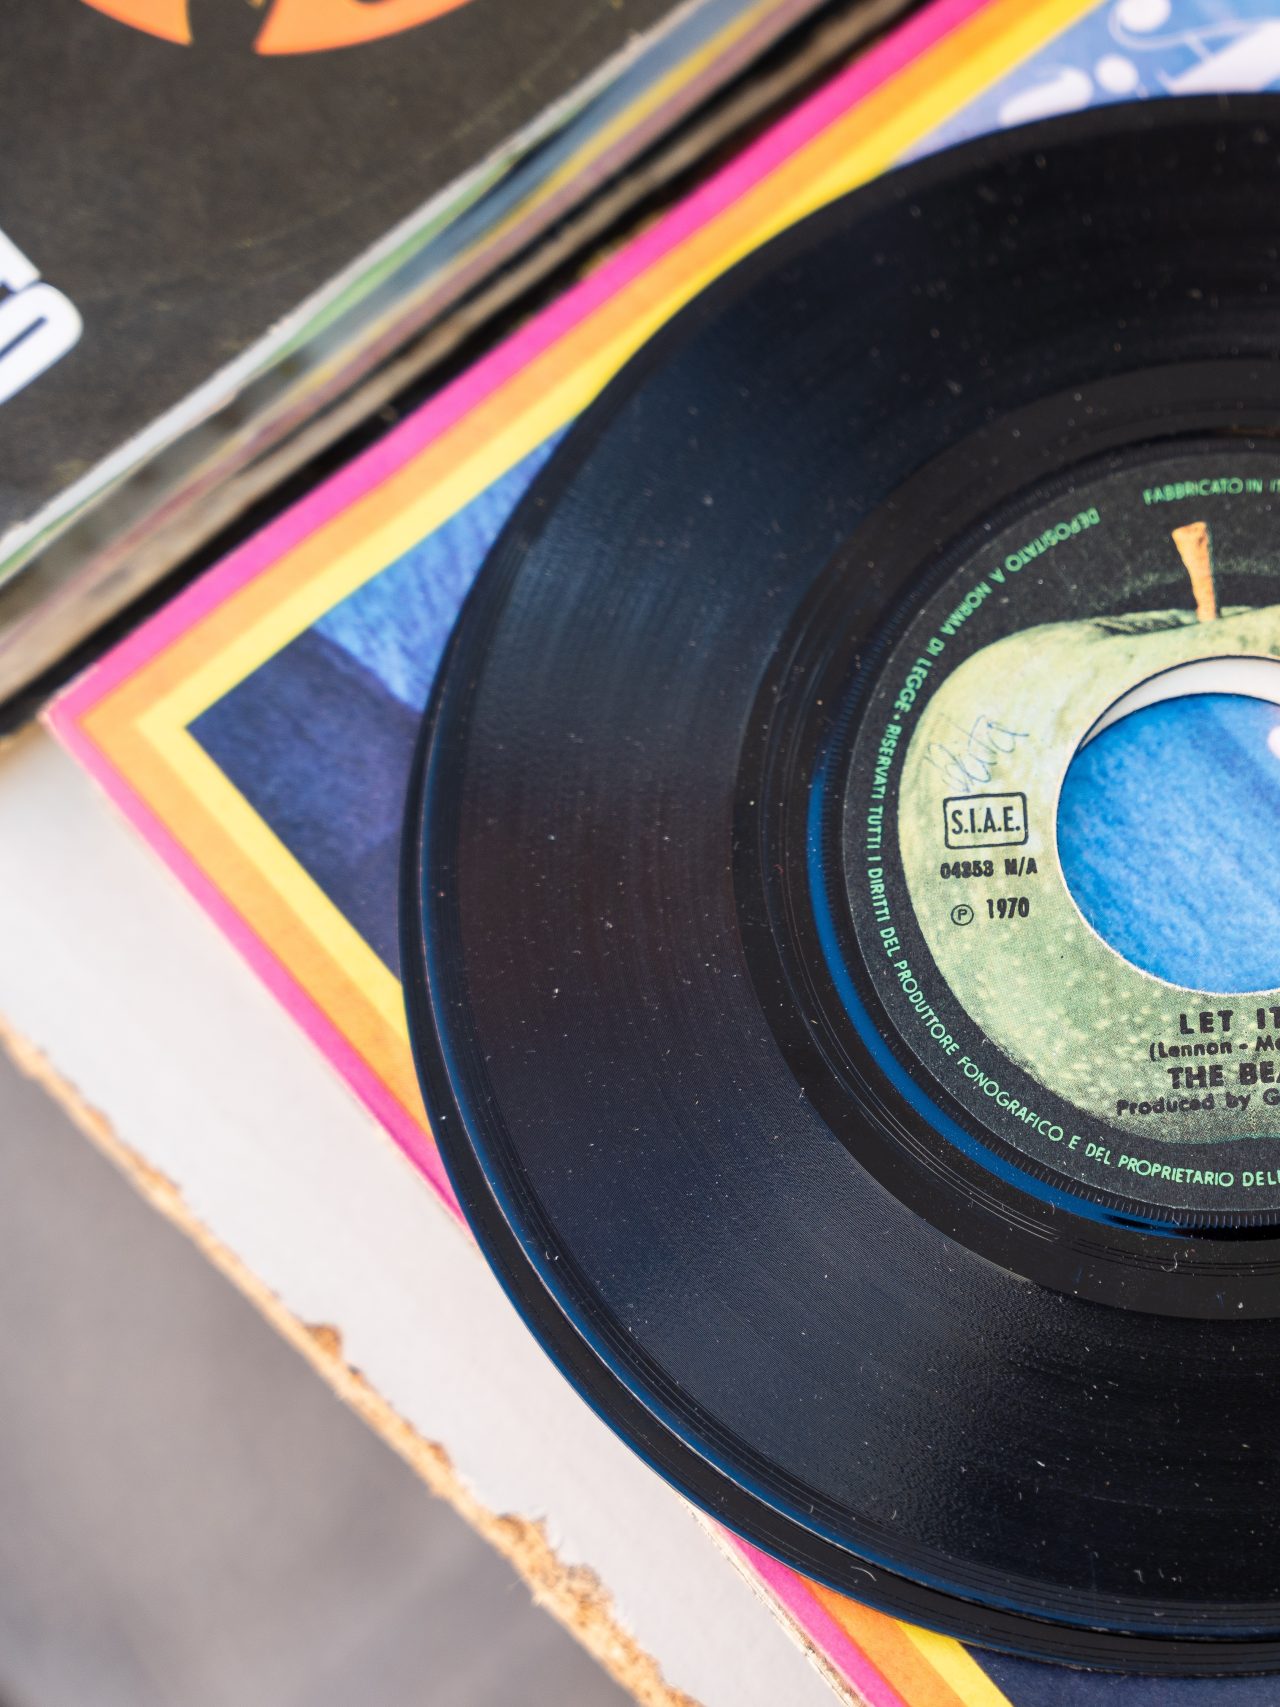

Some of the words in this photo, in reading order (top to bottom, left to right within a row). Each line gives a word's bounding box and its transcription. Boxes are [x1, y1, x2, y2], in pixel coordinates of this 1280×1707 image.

[1143, 478, 1243, 505] FABBRICATO
[1246, 479, 1263, 494] IN
[1005, 507, 1101, 572] DEPOSITATO
[988, 567, 1006, 584] A
[940, 581, 993, 636] NORMA
[926, 637, 946, 656] DI
[894, 657, 933, 713] LEGGE
[870, 723, 903, 800] RISERVATI
[866, 805, 884, 849] TUTTI
[951, 806, 1021, 834] S.I.A.E.
[867, 868, 891, 922] DIRITTI
[986, 897, 1030, 918] 1970
[879, 926, 901, 957] DEL
[894, 959, 960, 1056] PRODUTTORE
[1180, 1009, 1233, 1034] LET
[1150, 1041, 1232, 1062] (Lennon
[1168, 1065, 1224, 1089] THE
[957, 1056, 1064, 1142] FONOGRAFICO
[1116, 1093, 1214, 1116] Produced
[1225, 1092, 1251, 1111] by
[1068, 1135, 1082, 1150] E
[1085, 1143, 1111, 1165] DEL
[1117, 1154, 1235, 1188] PROPRIETARIO
